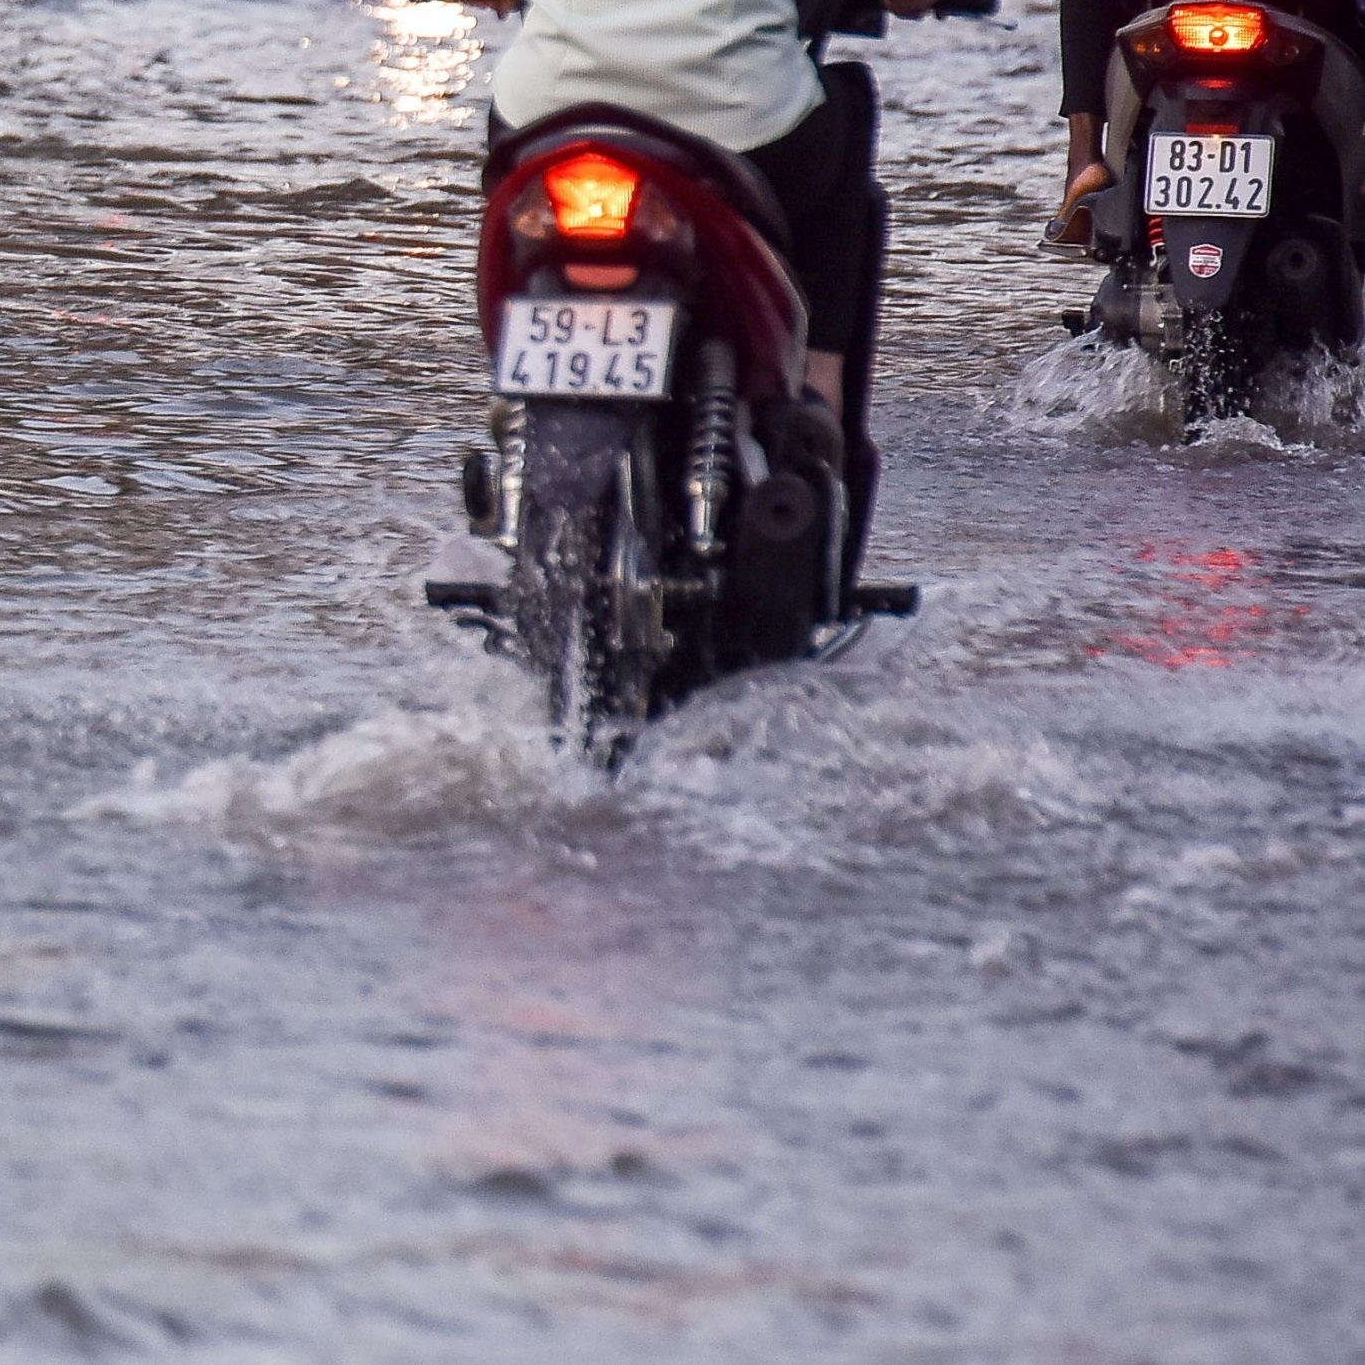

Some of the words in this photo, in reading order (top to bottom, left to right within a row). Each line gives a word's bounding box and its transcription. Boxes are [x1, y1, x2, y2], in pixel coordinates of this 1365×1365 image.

[1169, 139, 1252, 174] 83-D1
[1154, 175, 1264, 211] 302.42
[529, 306, 650, 346] 59-L3
